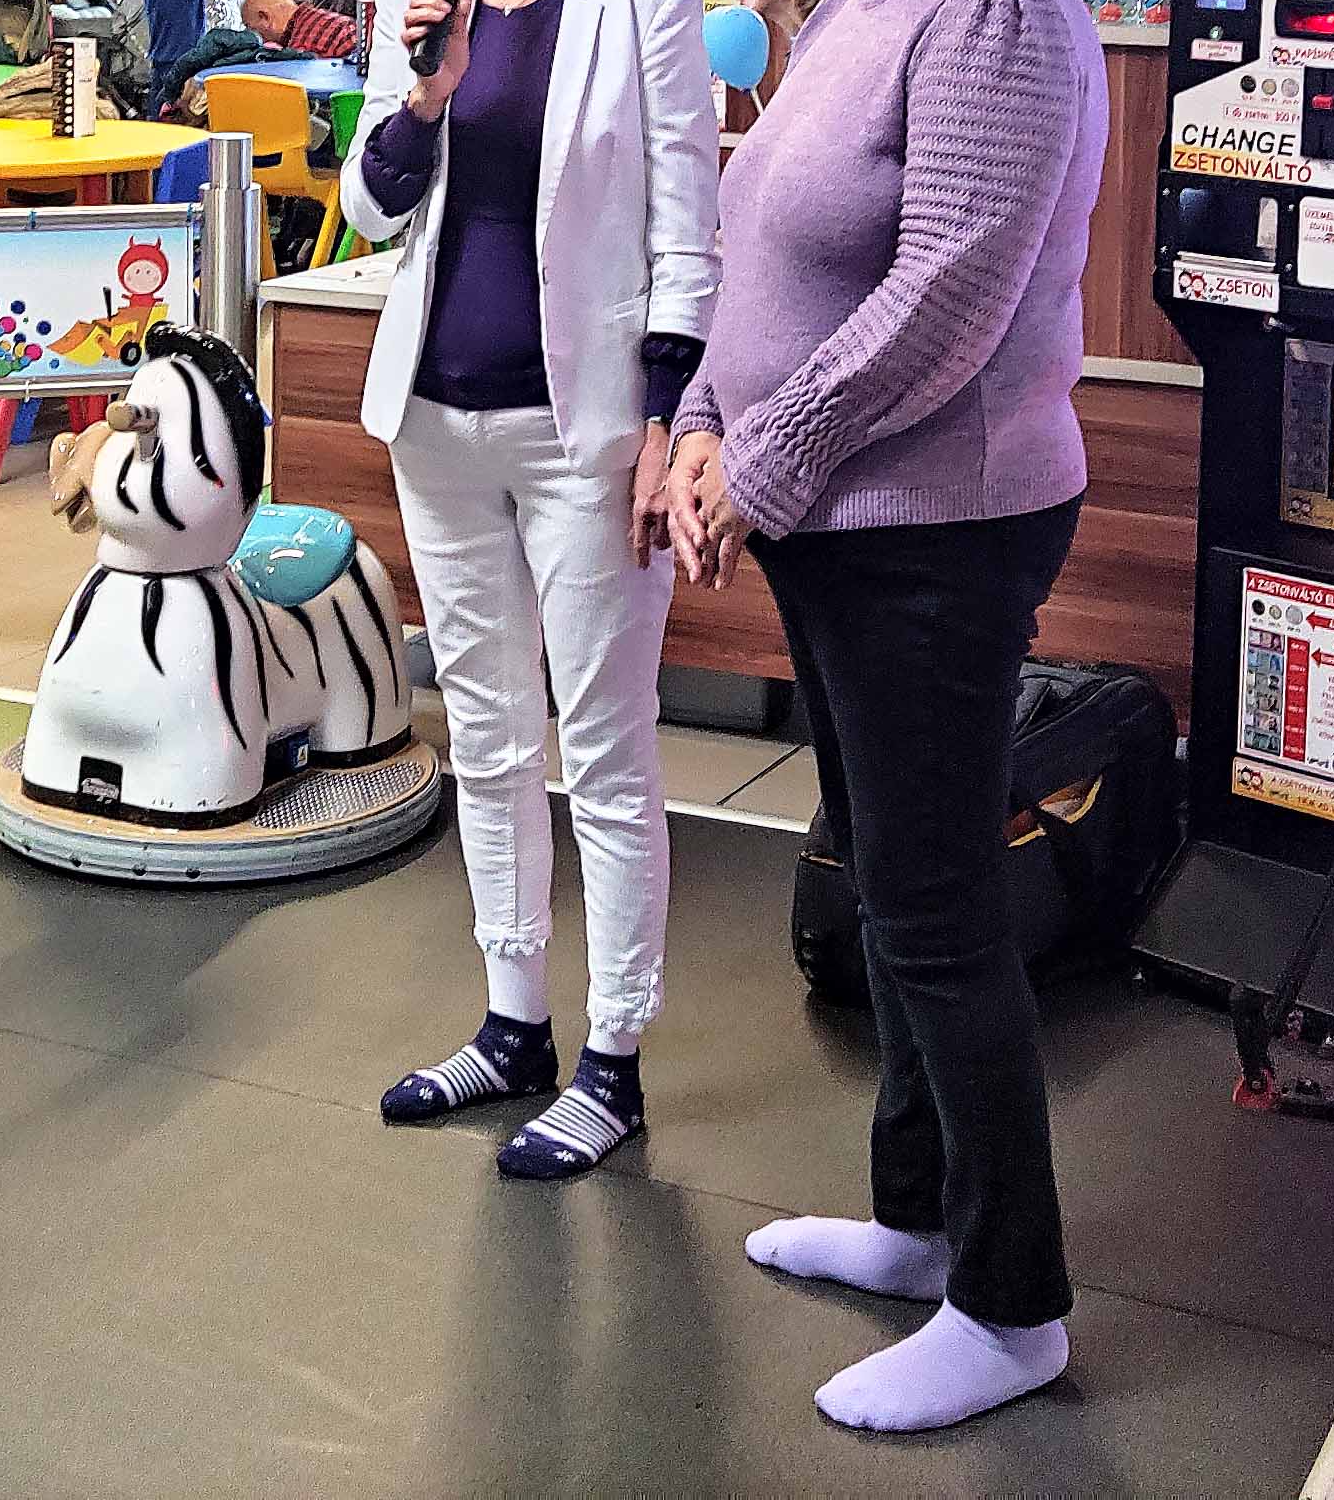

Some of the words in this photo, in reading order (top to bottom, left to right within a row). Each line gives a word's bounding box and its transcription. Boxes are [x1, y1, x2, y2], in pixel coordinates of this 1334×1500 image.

[1181, 123, 1297, 157] CHANGE
[1173, 150, 1313, 183] ZSETONVÁLTÓ
[1215, 277, 1274, 298] ZSETON
[1247, 577, 1256, 589] A
[1257, 578, 1324, 604] ZSETONVÁLTÓ
